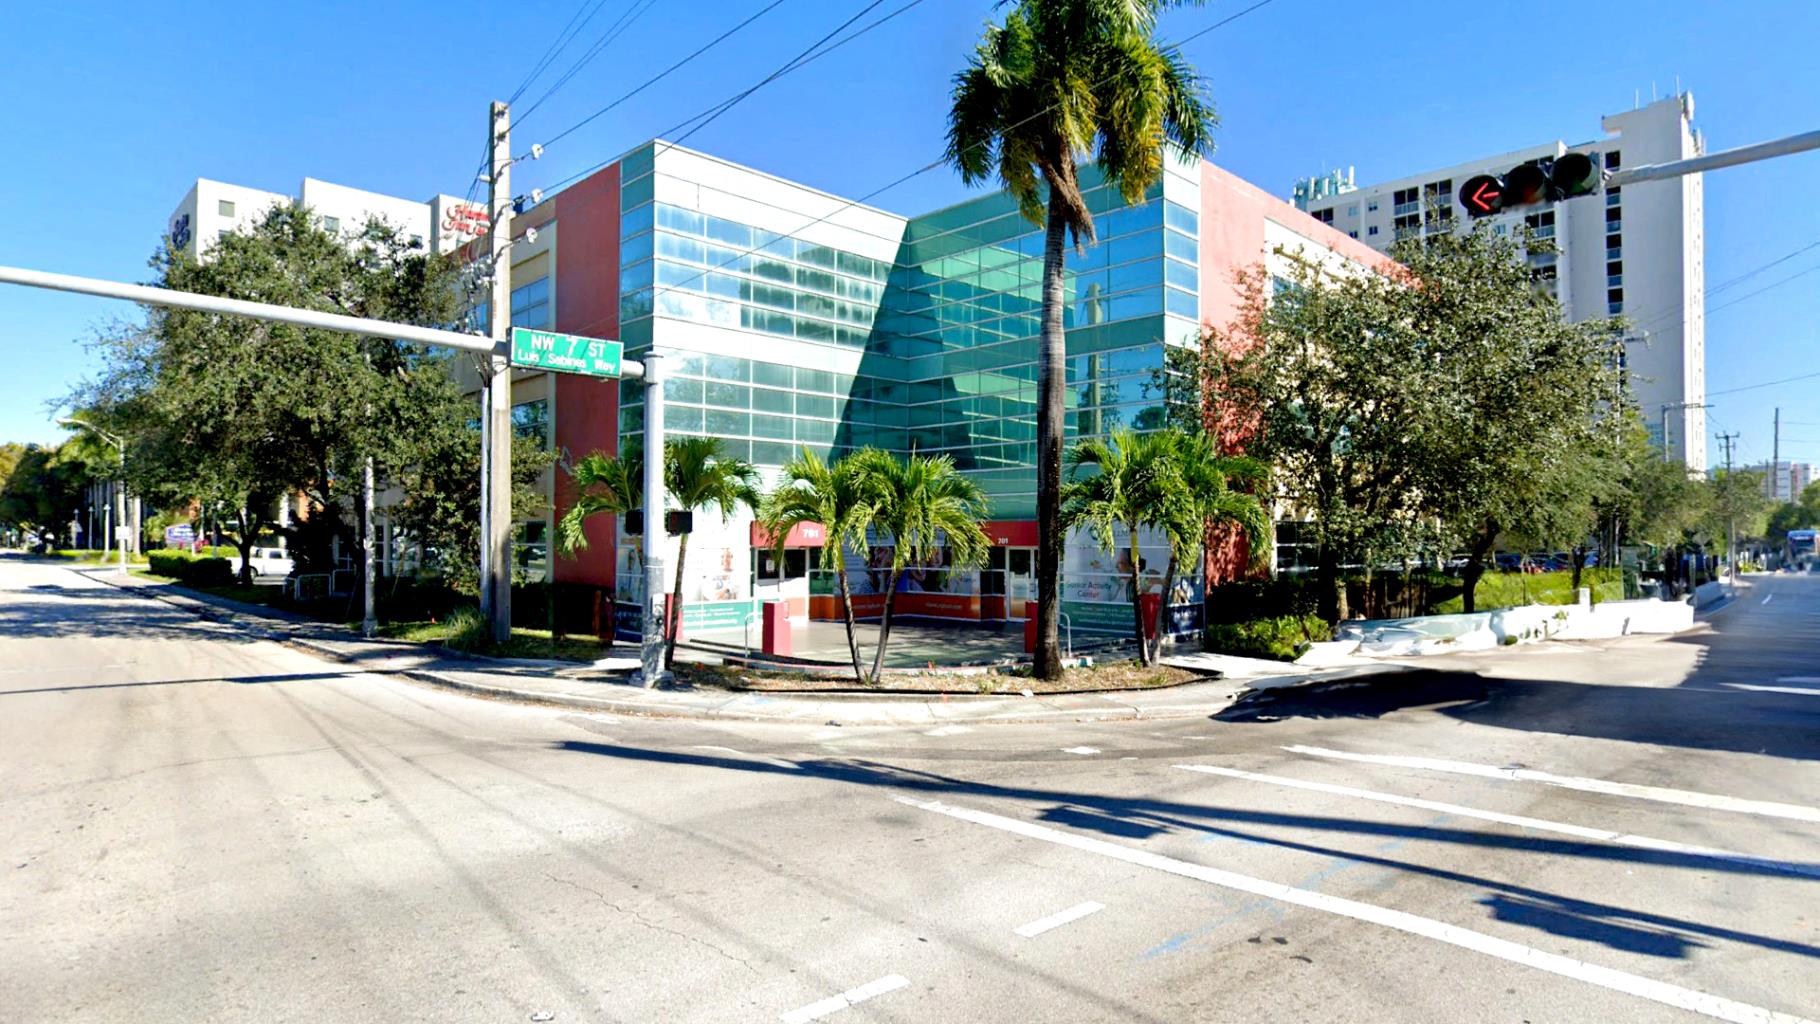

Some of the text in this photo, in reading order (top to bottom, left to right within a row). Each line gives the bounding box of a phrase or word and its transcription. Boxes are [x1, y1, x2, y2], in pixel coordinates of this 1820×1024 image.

[532, 334, 606, 358] NW 7 ST
[517, 348, 540, 363] Luis
[594, 359, 616, 375] Way
